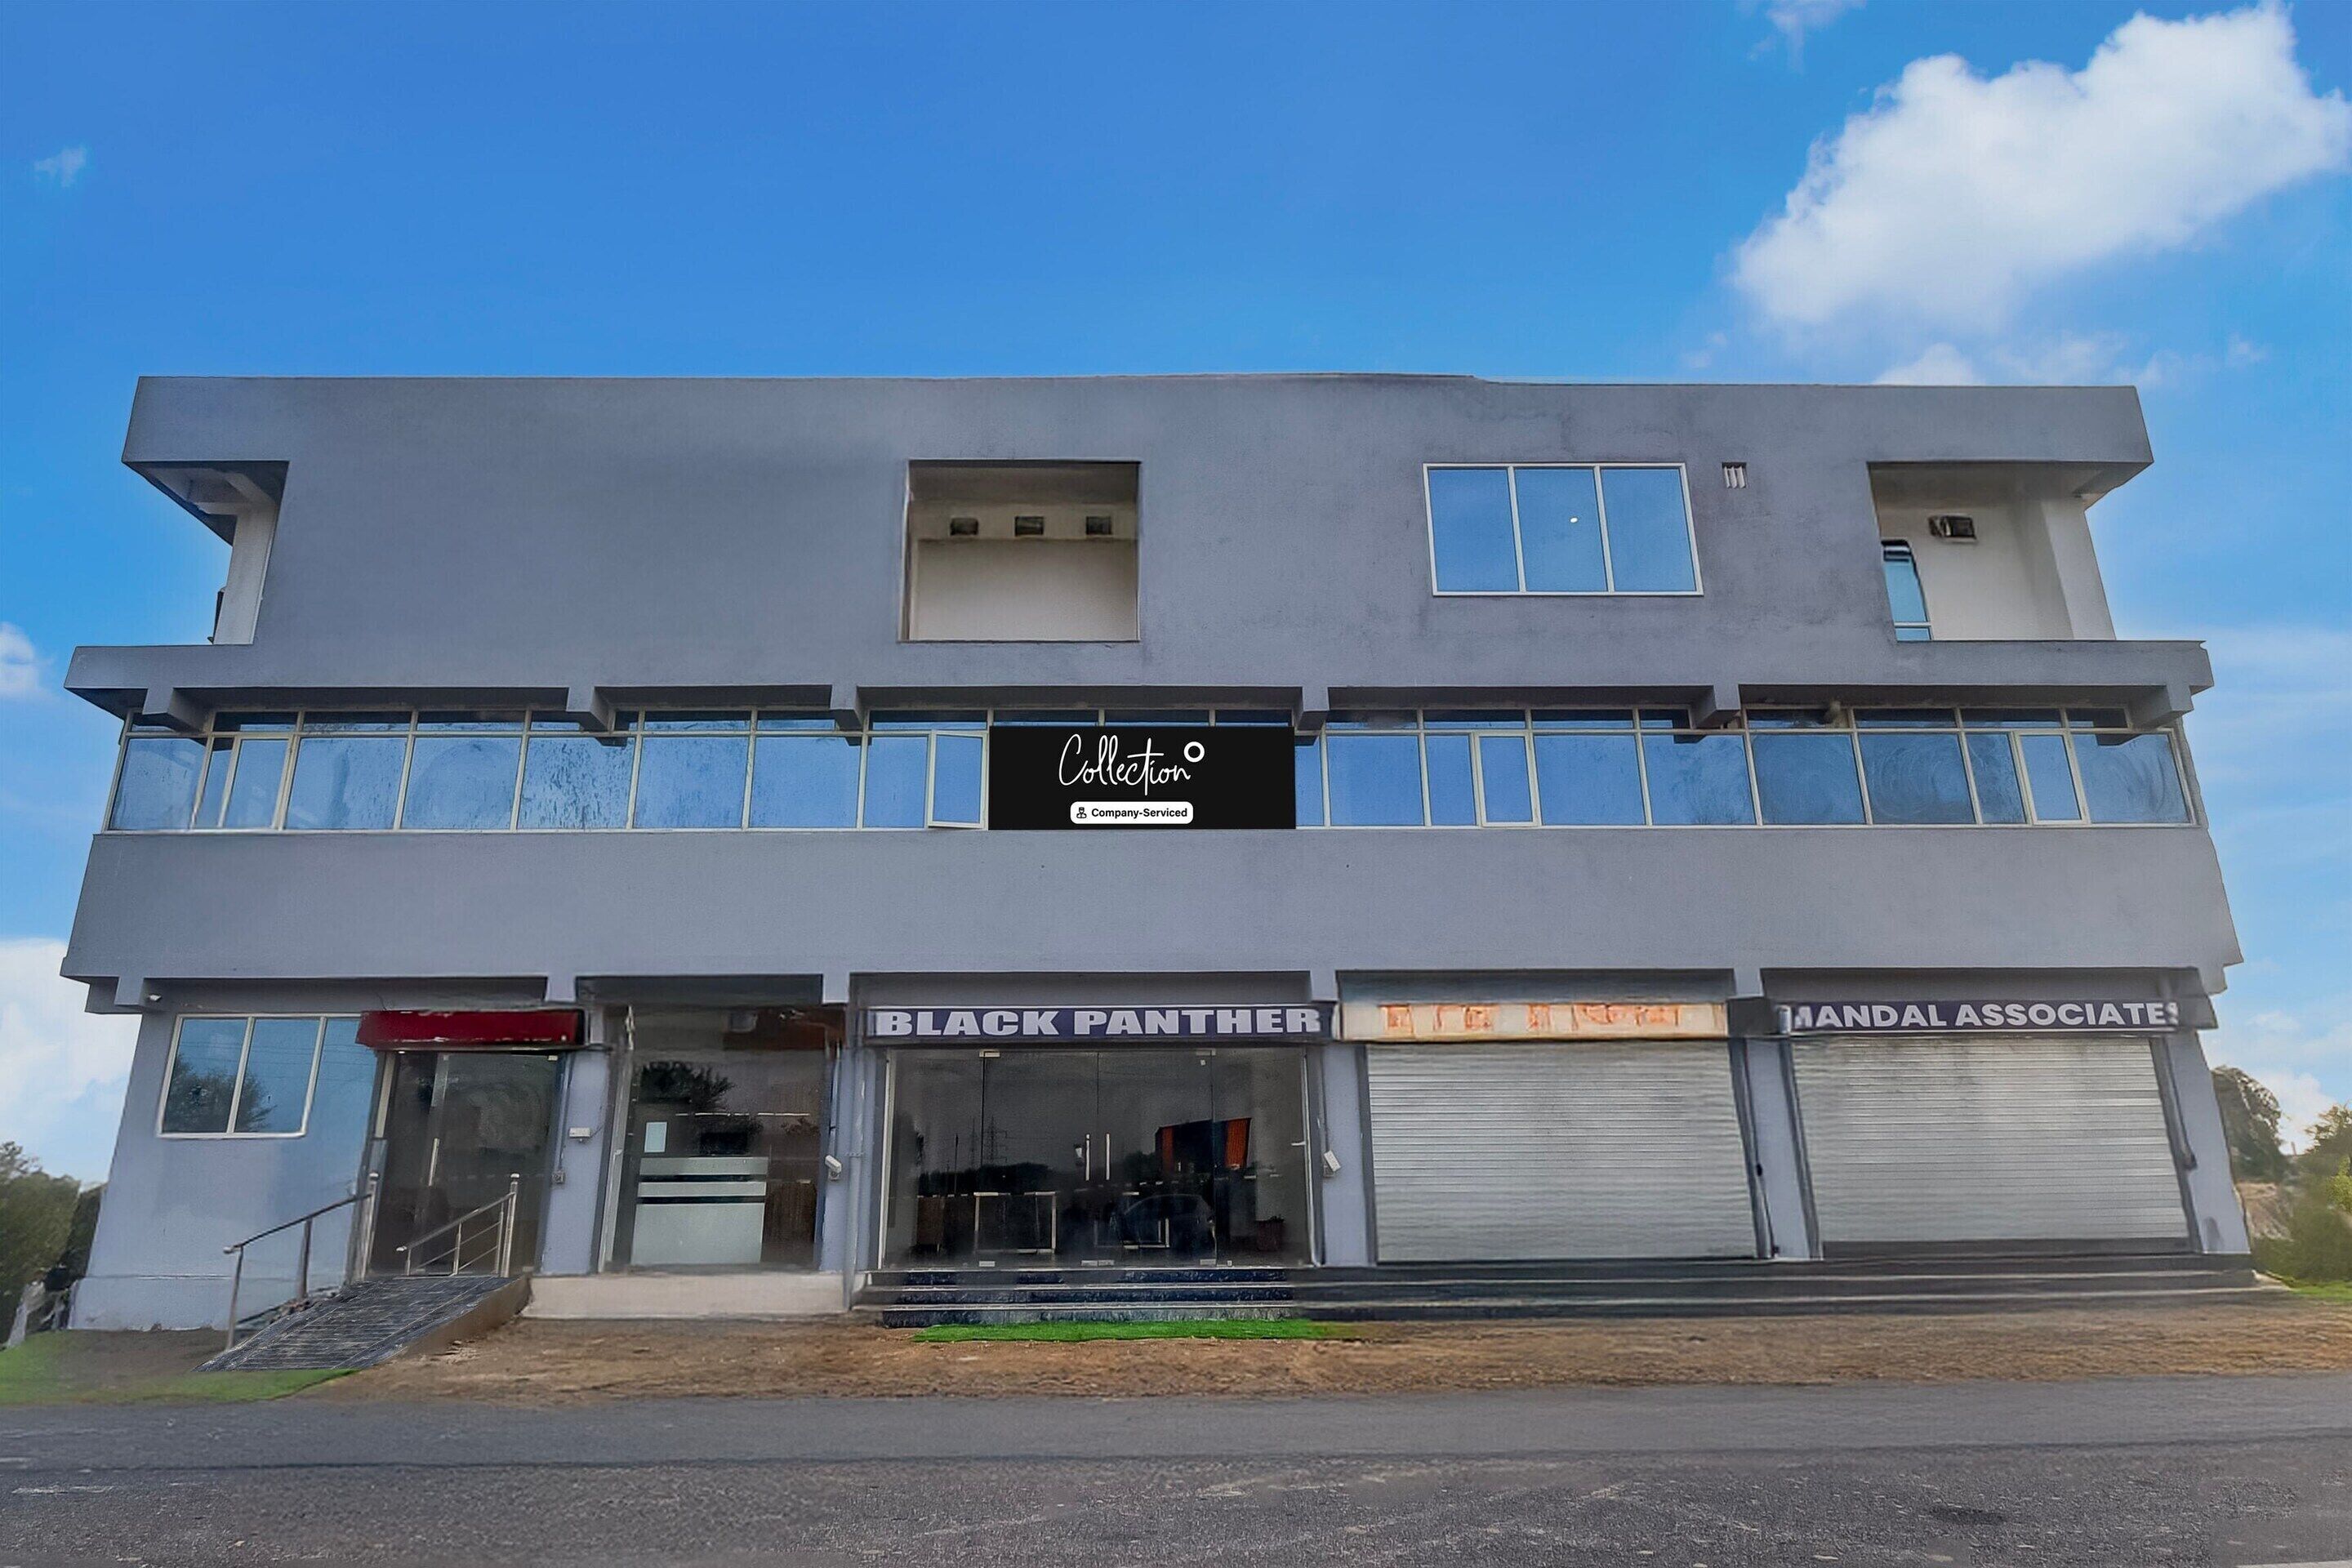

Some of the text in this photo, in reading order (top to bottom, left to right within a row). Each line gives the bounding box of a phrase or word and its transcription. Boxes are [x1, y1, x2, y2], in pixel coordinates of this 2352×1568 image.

[1058, 733, 1191, 796] Collection
[1091, 808, 1188, 819] Company-Serviced
[876, 1009, 1321, 1036] BLACK PANTHER
